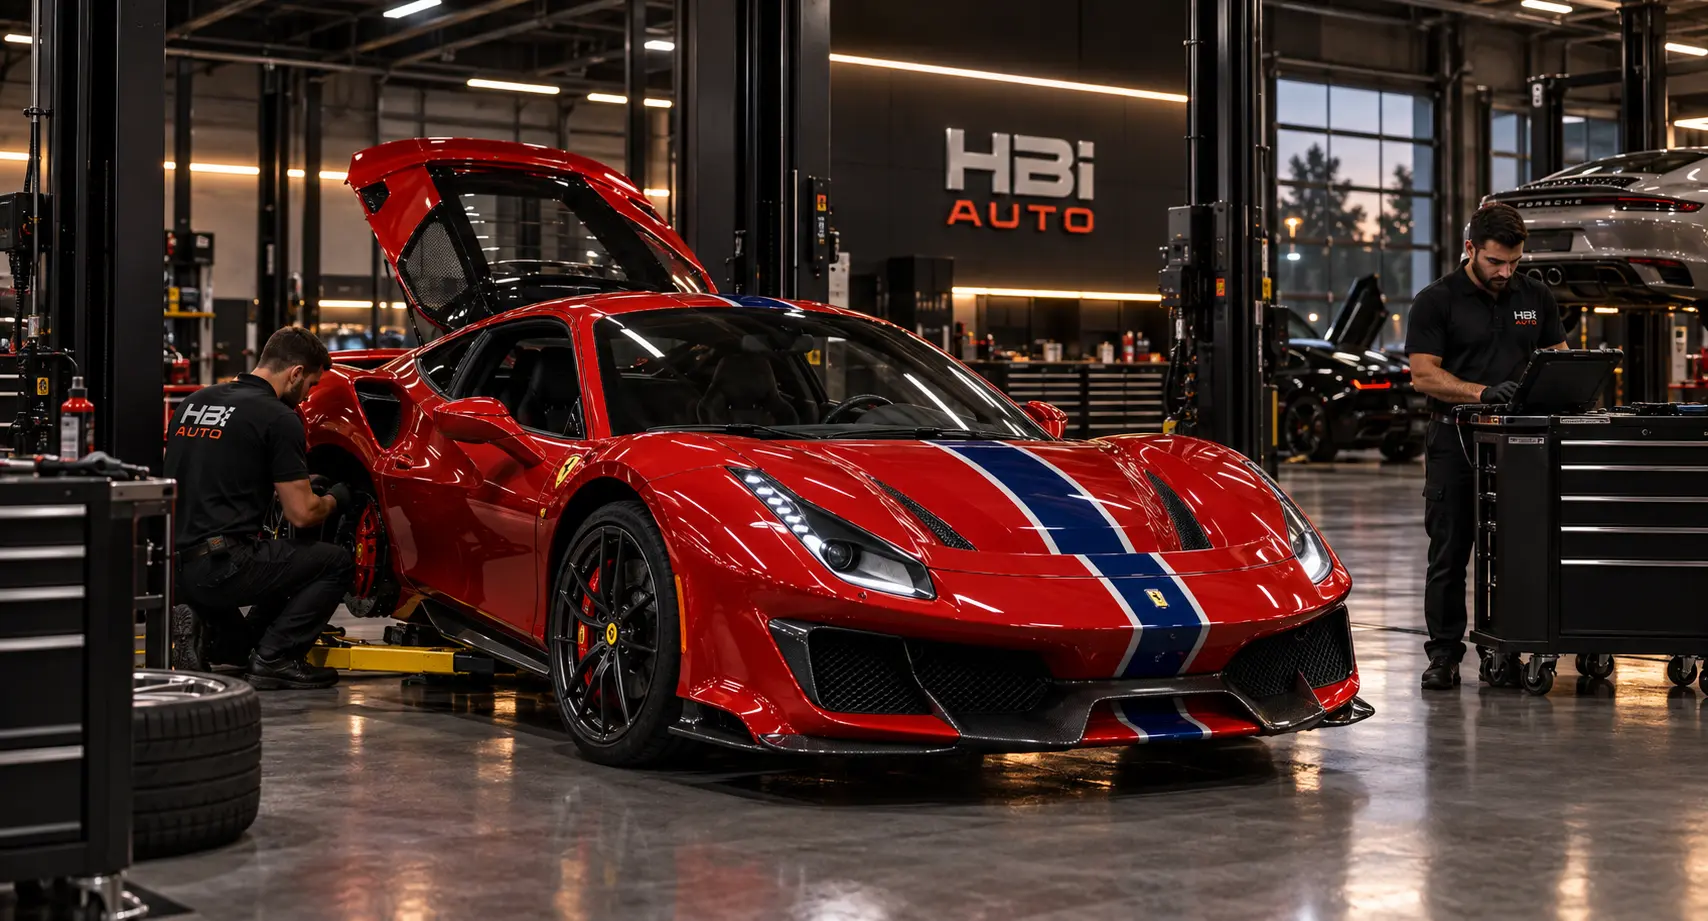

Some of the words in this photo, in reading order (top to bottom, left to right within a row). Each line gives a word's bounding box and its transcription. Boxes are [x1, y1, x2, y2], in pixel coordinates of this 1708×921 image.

[946, 128, 1094, 200] HBi
[947, 199, 1094, 234] AUTO
[175, 426, 222, 440] AUTO
